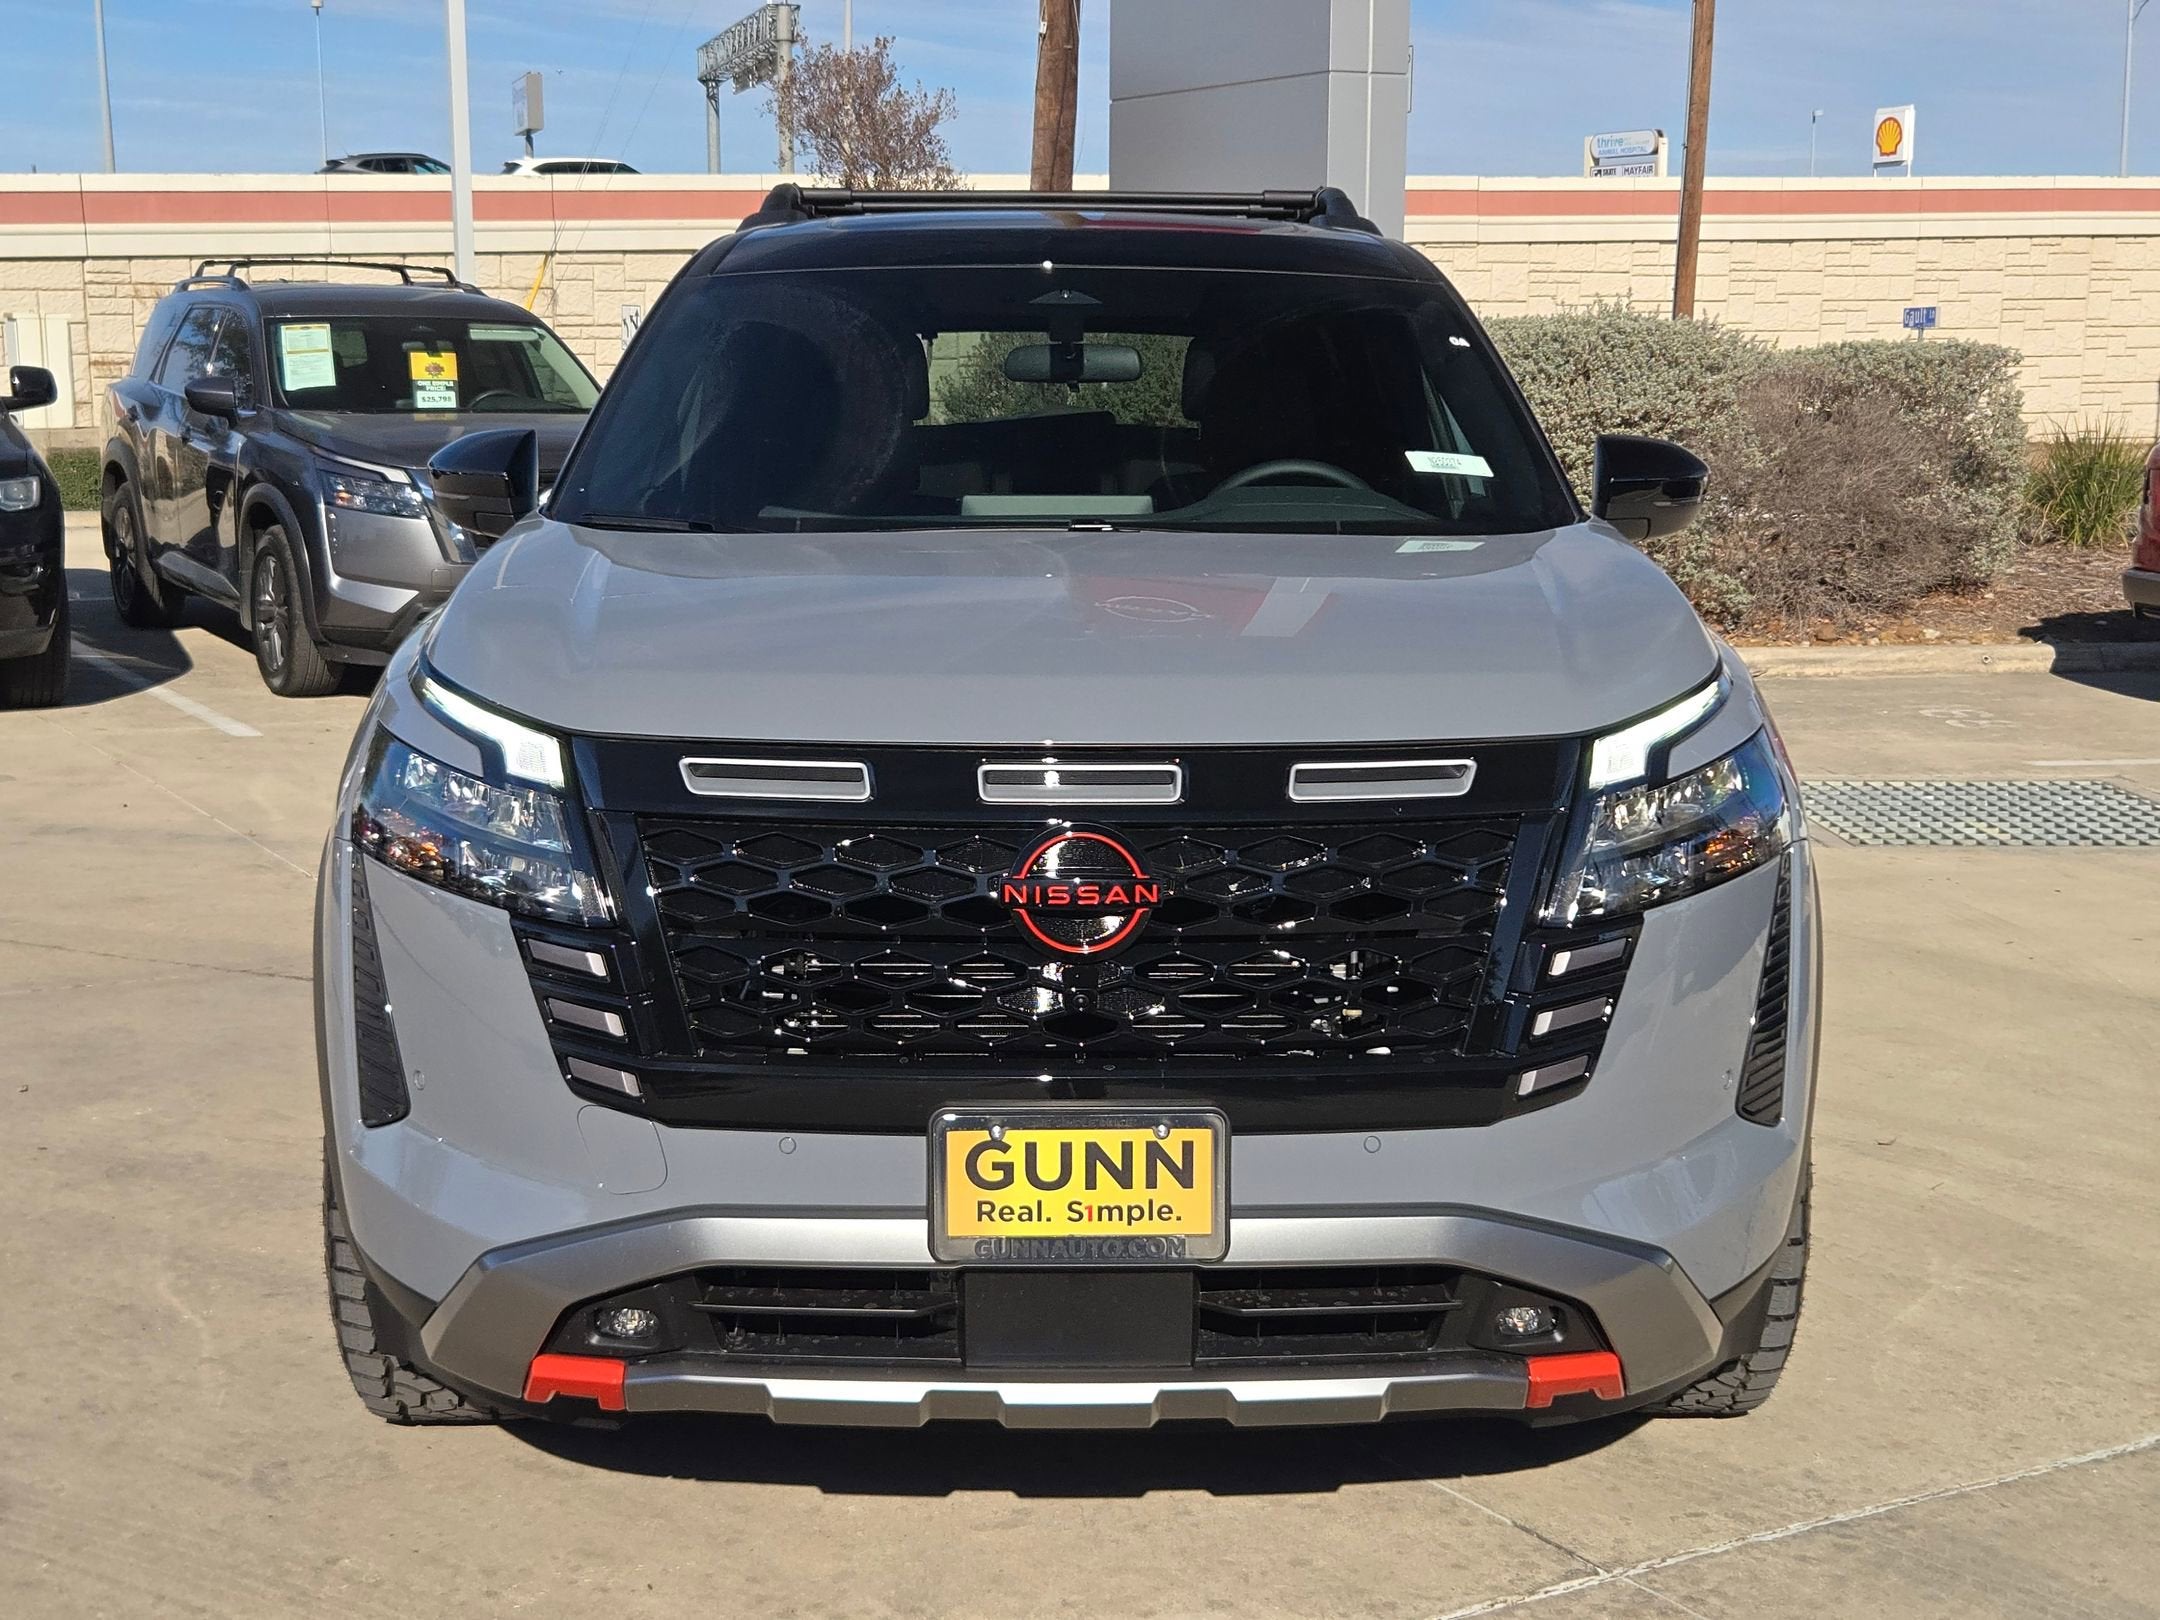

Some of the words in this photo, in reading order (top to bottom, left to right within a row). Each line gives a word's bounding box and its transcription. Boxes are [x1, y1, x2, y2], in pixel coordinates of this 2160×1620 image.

[1597, 135, 1624, 149] thrive
[1620, 145, 1649, 154] HOSPITAL
[1624, 165, 1654, 175] MAYFAIR
[1904, 308, 1926, 326] Gault
[1004, 884, 1159, 905] NISSAN
[965, 1139, 1194, 1191] GUNN
[976, 1199, 1052, 1222] Real.
[974, 1237, 1186, 1259] GUNNAUTO.COM
